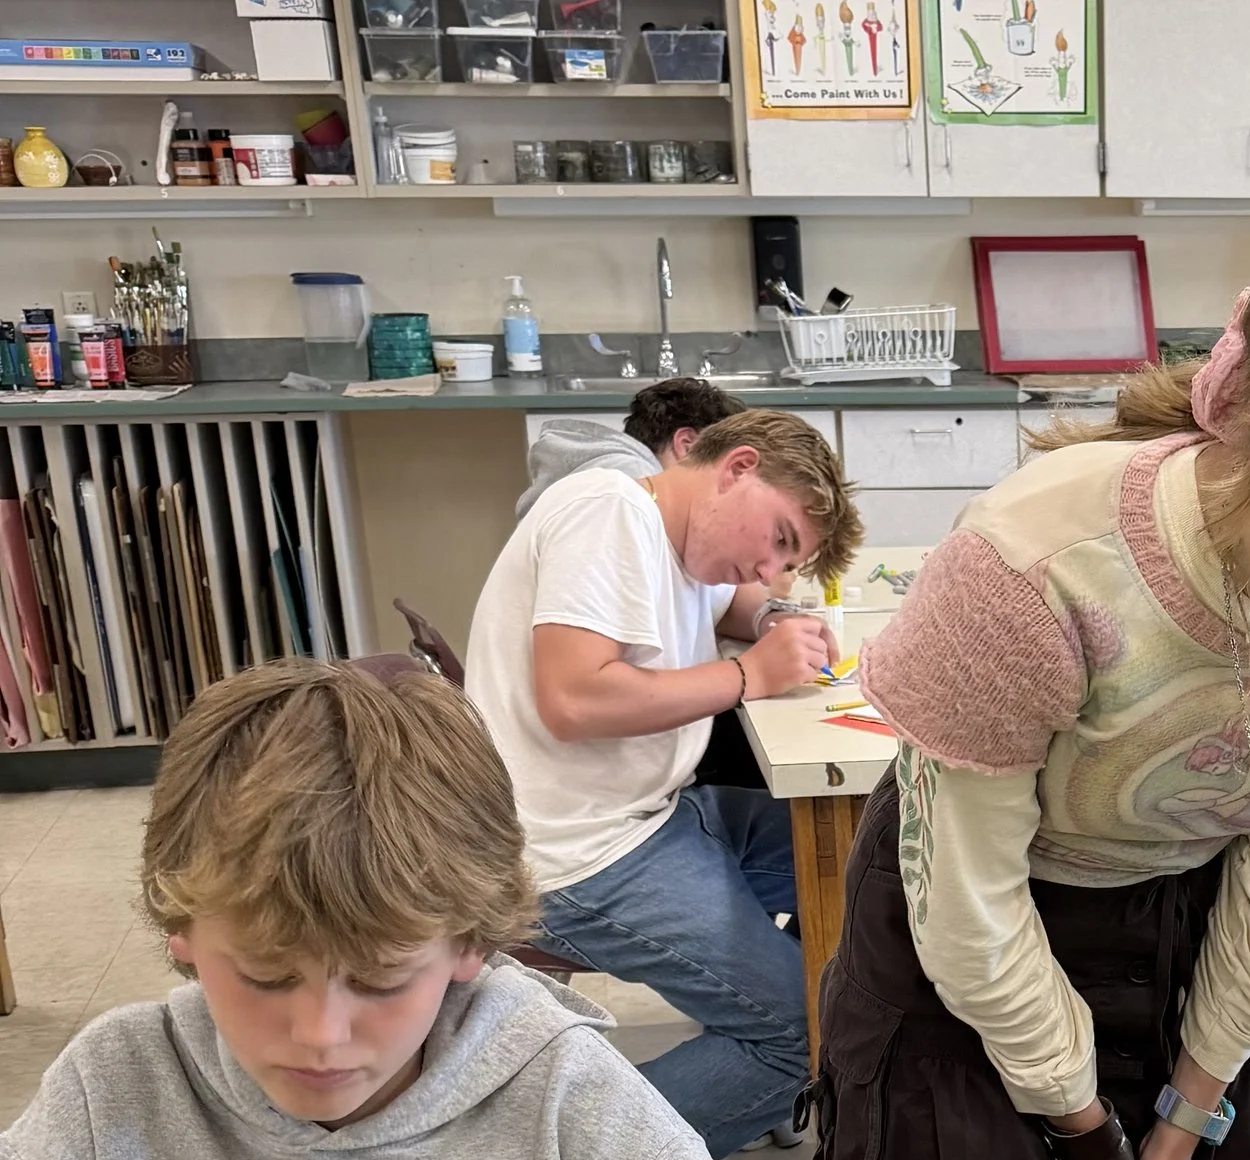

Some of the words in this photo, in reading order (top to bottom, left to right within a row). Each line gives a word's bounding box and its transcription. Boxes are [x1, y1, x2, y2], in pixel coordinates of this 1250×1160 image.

[821, 89, 850, 99] Paint
[853, 89, 880, 99] With
[161, 187, 168, 198] 5
[556, 186, 564, 196] 6
